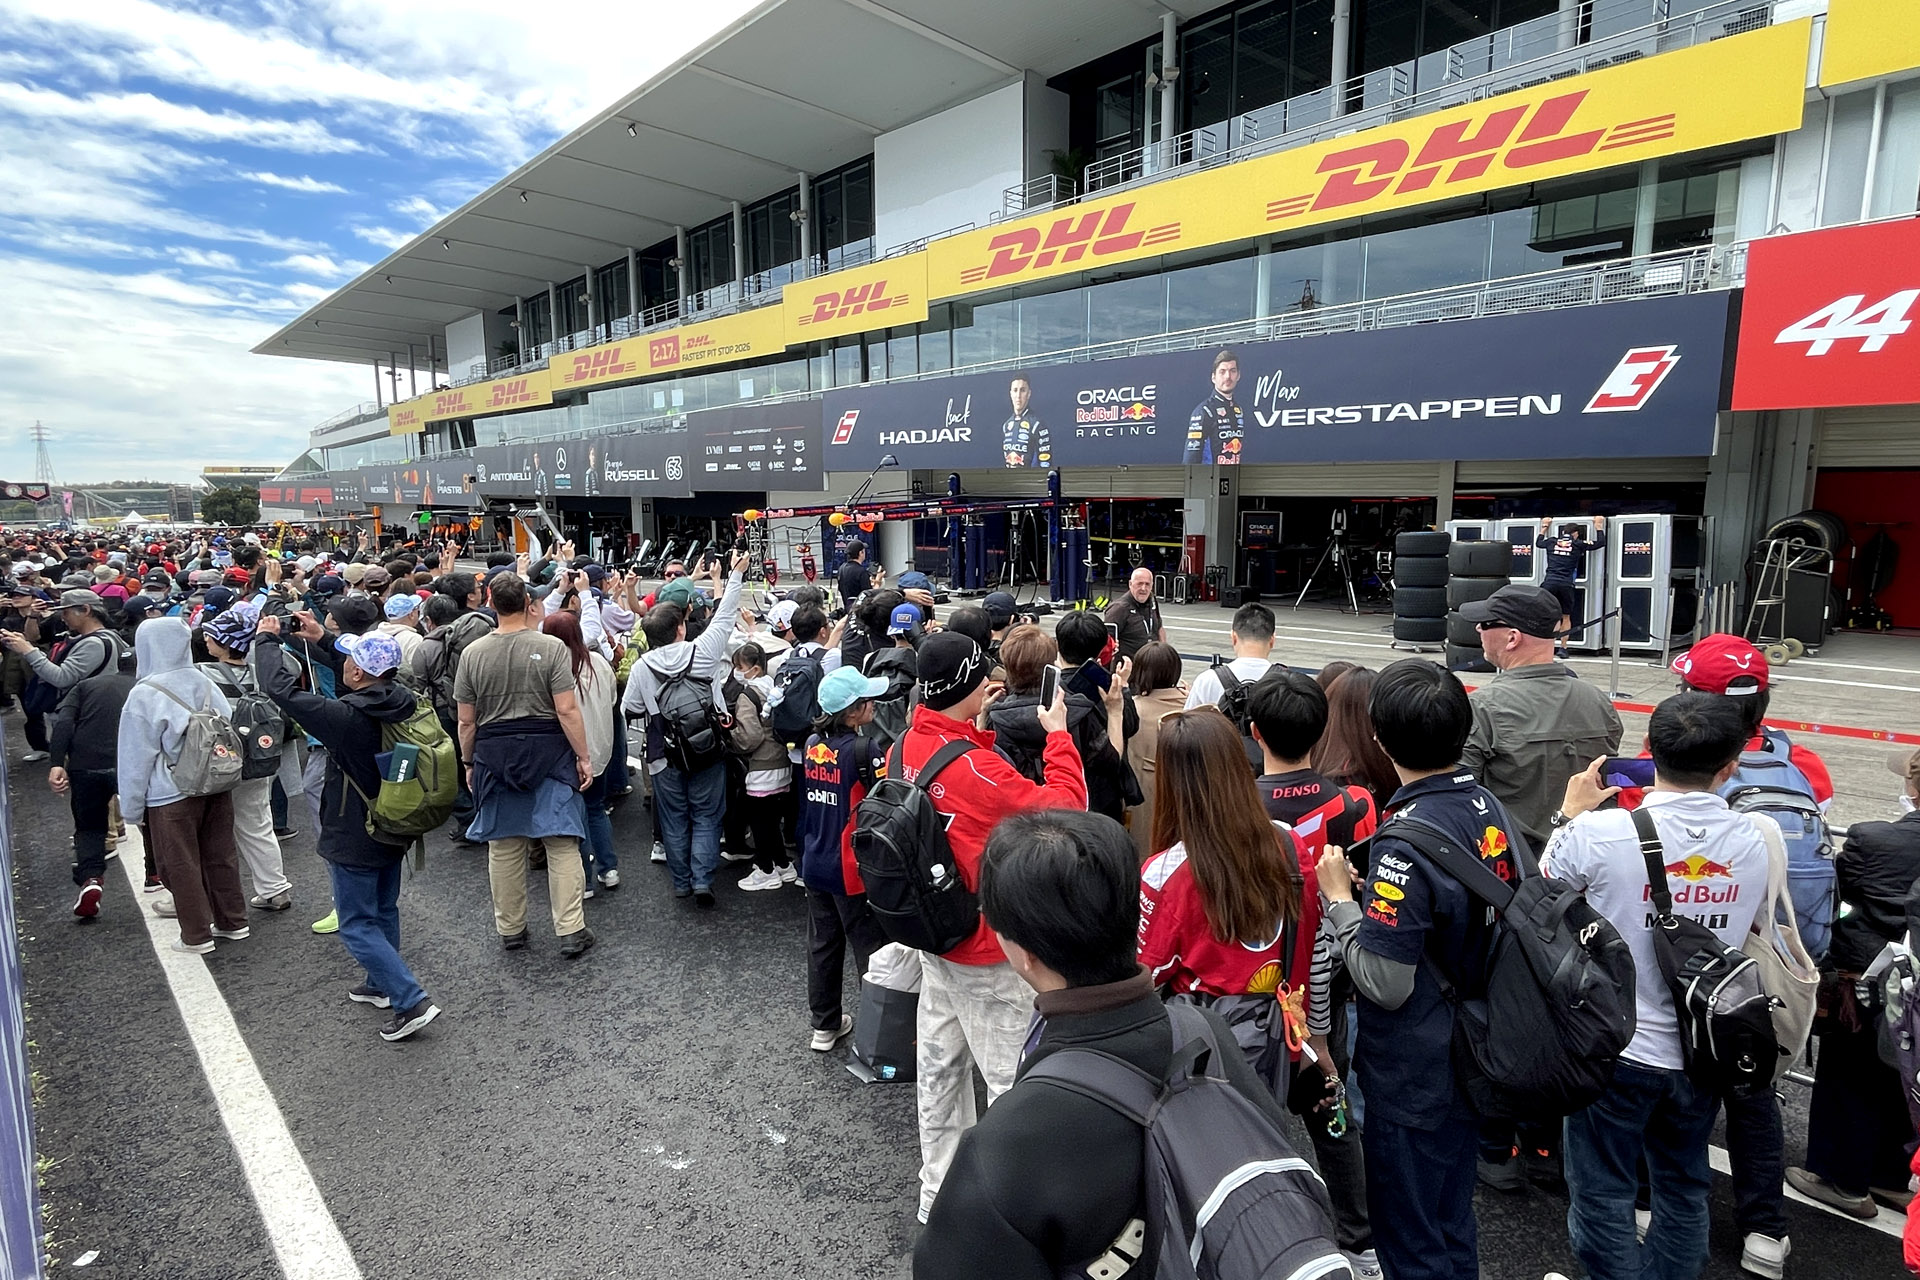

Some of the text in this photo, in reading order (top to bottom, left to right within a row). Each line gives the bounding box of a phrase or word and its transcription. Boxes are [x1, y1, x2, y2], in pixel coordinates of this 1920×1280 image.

[1308, 89, 1608, 213] DHL
[984, 201, 1147, 279] DHL
[811, 280, 895, 324] DHL
[1773, 288, 1920, 357] 44
[686, 334, 710, 349] DHL
[652, 342, 678, 362] 2.17s
[682, 342, 751, 362] FASTEST PIT STOP 2026
[573, 347, 626, 382] DHL
[1582, 344, 1682, 413] 3
[492, 379, 531, 407] DHL
[1076, 385, 1157, 405] ORACLE
[1253, 369, 1300, 412] Max
[436, 392, 467, 415] DHL
[945, 394, 971, 428] Isack
[1253, 393, 1562, 428] VERSTAPPEN
[396, 410, 416, 427] DHL
[831, 409, 860, 445] 6
[879, 427, 972, 446] HADJAR
[1076, 426, 1156, 438] RACING
[1003, 443, 1028, 453] ORACLE
[476, 464, 487, 483] 12
[490, 472, 532, 481] ANTONELLI
[605, 469, 660, 482] RUSSELL
[665, 455, 683, 480] 63
[437, 486, 462, 494] PIASTRI
[1220, 481, 1229, 494] 15
[820, 766, 840, 785] Bull
[1272, 783, 1321, 799] DENSO
[1379, 853, 1413, 872] telcel
[1376, 864, 1410, 886] ROKT
[1693, 884, 1740, 904] Bull
[1380, 912, 1399, 928] Bull
